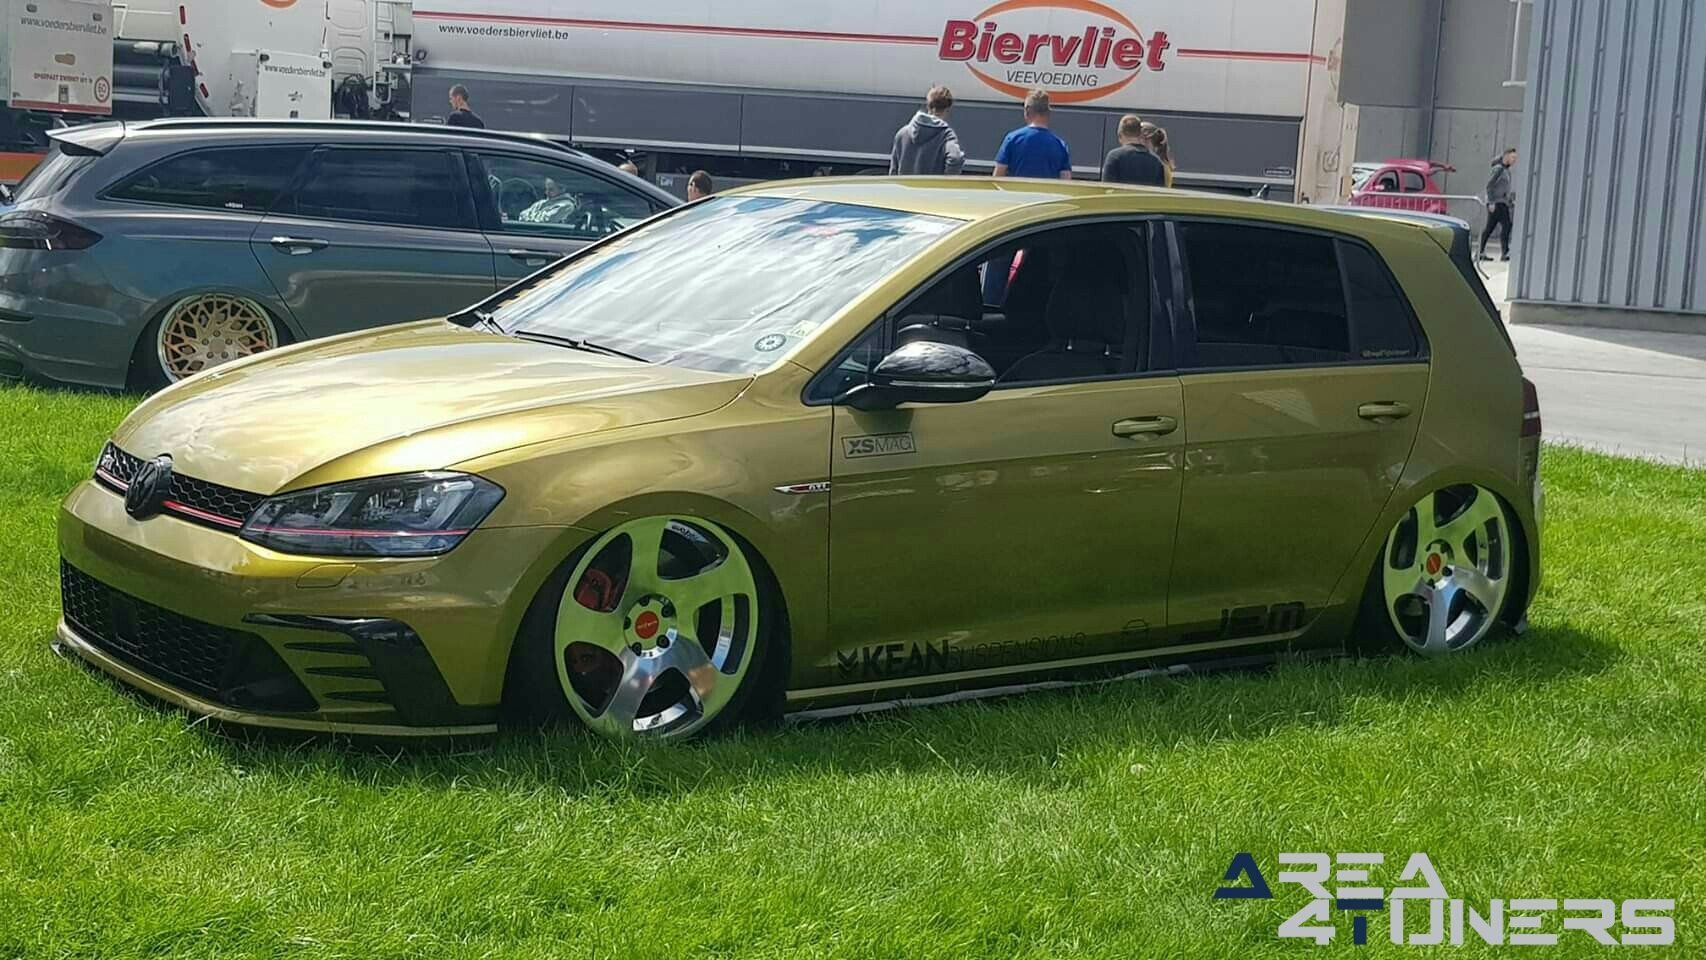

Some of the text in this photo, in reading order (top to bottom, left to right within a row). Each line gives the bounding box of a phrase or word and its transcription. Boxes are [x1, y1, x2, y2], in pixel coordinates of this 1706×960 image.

[437, 24, 569, 40] www.voedersbiervliet.be
[938, 19, 1171, 71] Biervliet
[1006, 69, 1099, 87] VEEVOEDING
[848, 435, 912, 455] XSMAG
